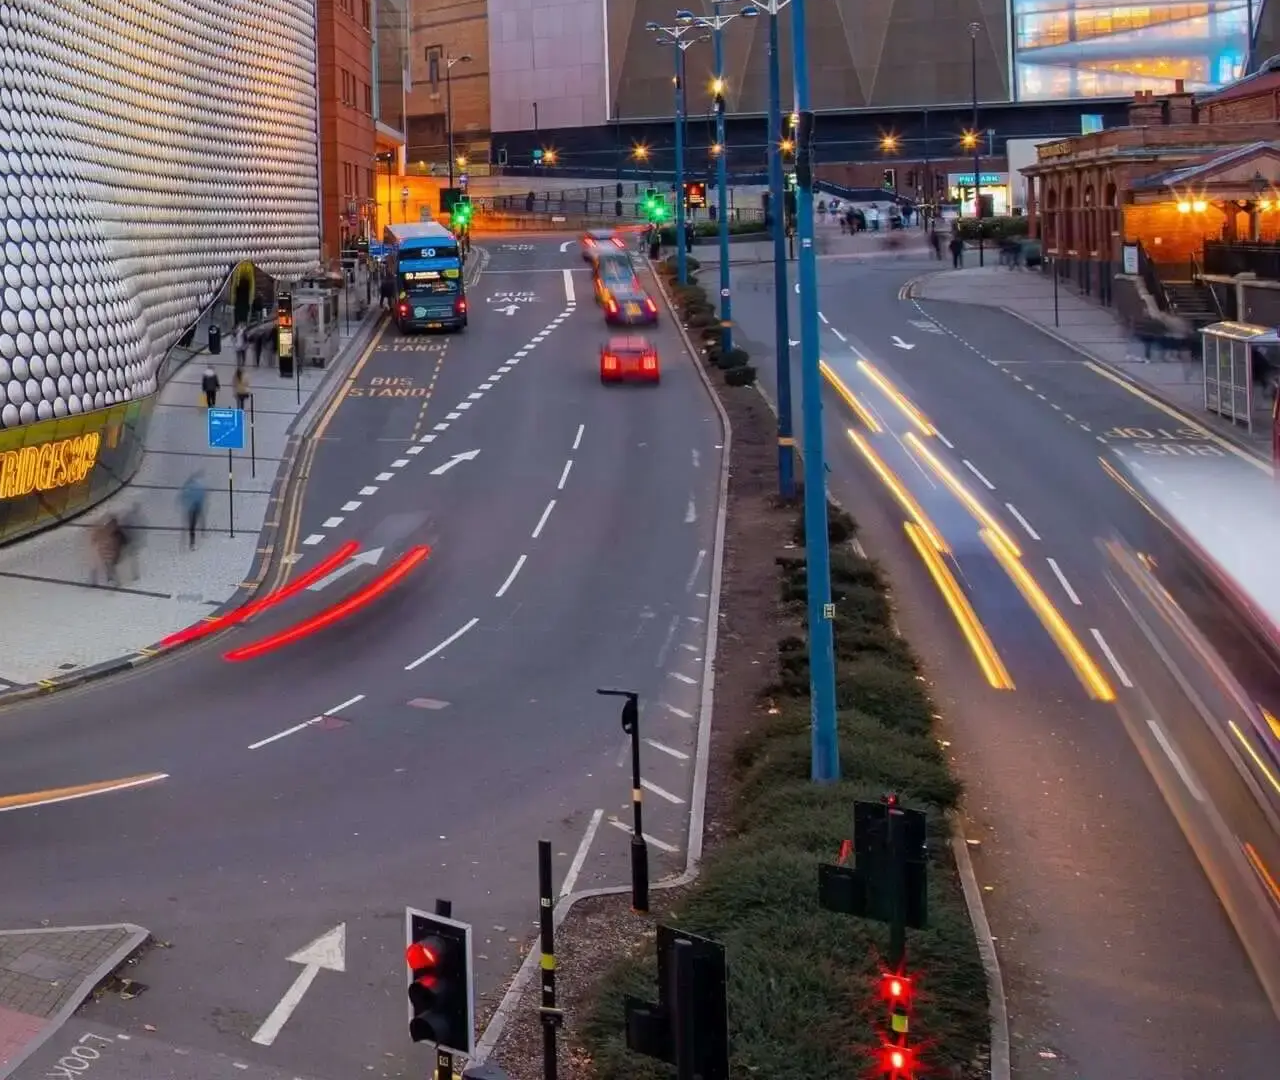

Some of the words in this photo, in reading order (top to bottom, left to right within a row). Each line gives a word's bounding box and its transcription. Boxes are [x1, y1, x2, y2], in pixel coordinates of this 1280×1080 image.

[959, 175, 1001, 184] PRIARK
[420, 248, 436, 257] 50
[375, 344, 441, 352] STAND
[370, 376, 414, 387] BUS
[348, 387, 427, 398] STAND
